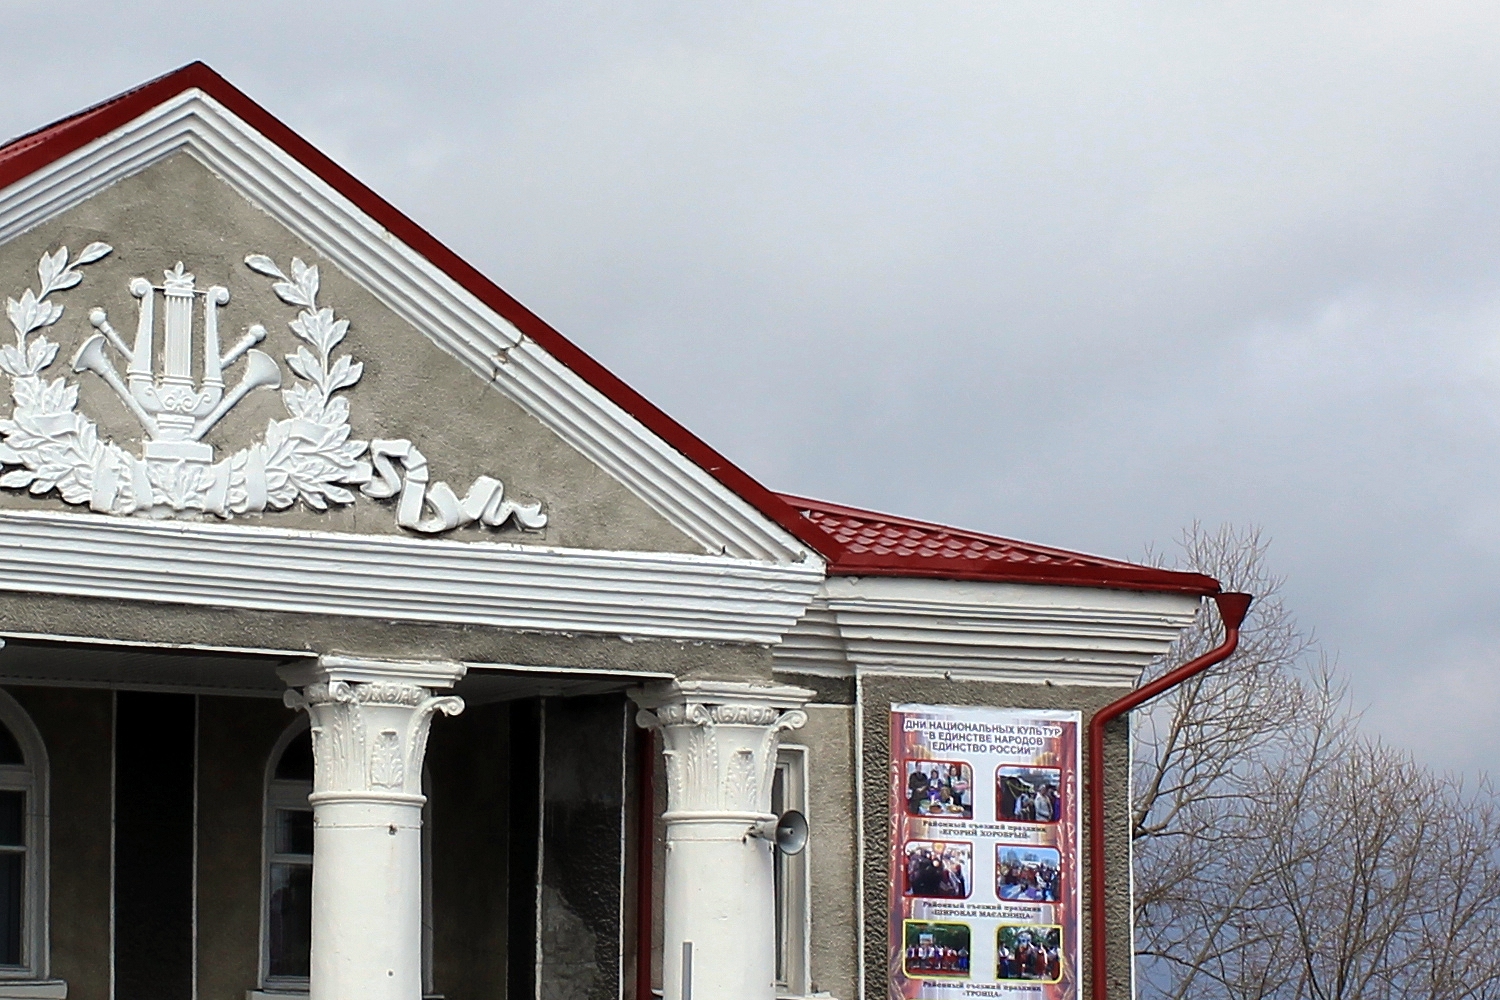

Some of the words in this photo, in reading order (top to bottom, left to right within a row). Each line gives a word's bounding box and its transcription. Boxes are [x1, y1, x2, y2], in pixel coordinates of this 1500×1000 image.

[905, 720, 926, 729] ДНИ
[929, 721, 1014, 734] НАЦИОНАЛЬНЫХ
[1018, 726, 1061, 737] КУЛЬТУР
[939, 732, 992, 743] ЕДИНСТВЕ
[995, 736, 1043, 746] НАРОДОВ
[932, 742, 987, 753] ЕДИНСТВО
[923, 820, 966, 828] Районный
